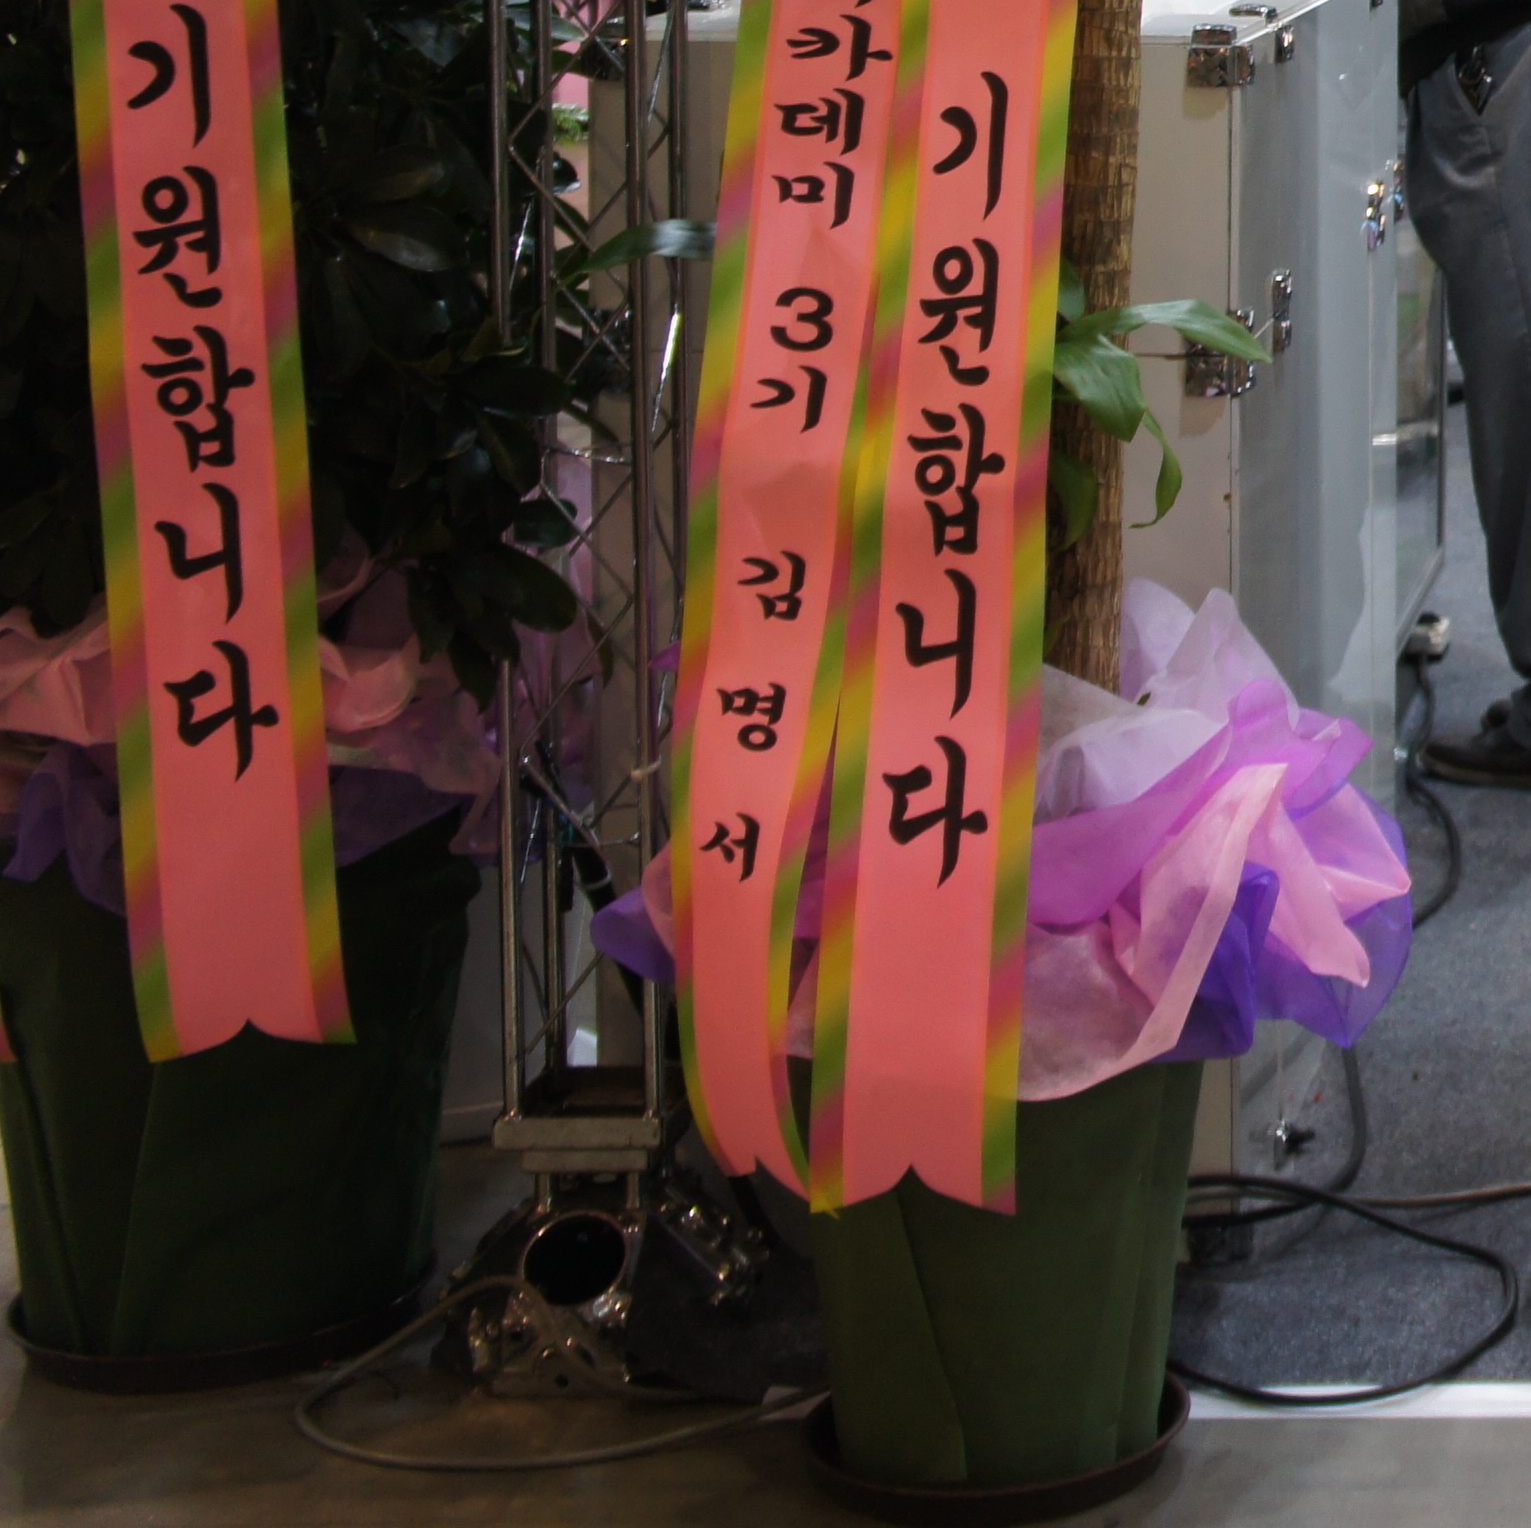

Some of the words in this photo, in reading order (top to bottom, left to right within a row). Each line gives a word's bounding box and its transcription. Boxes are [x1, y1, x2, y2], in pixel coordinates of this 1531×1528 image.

[127, 2, 280, 783] 기원합니다
[749, 285, 835, 434] 3기
[881, 71, 1009, 889] 기원합니다
